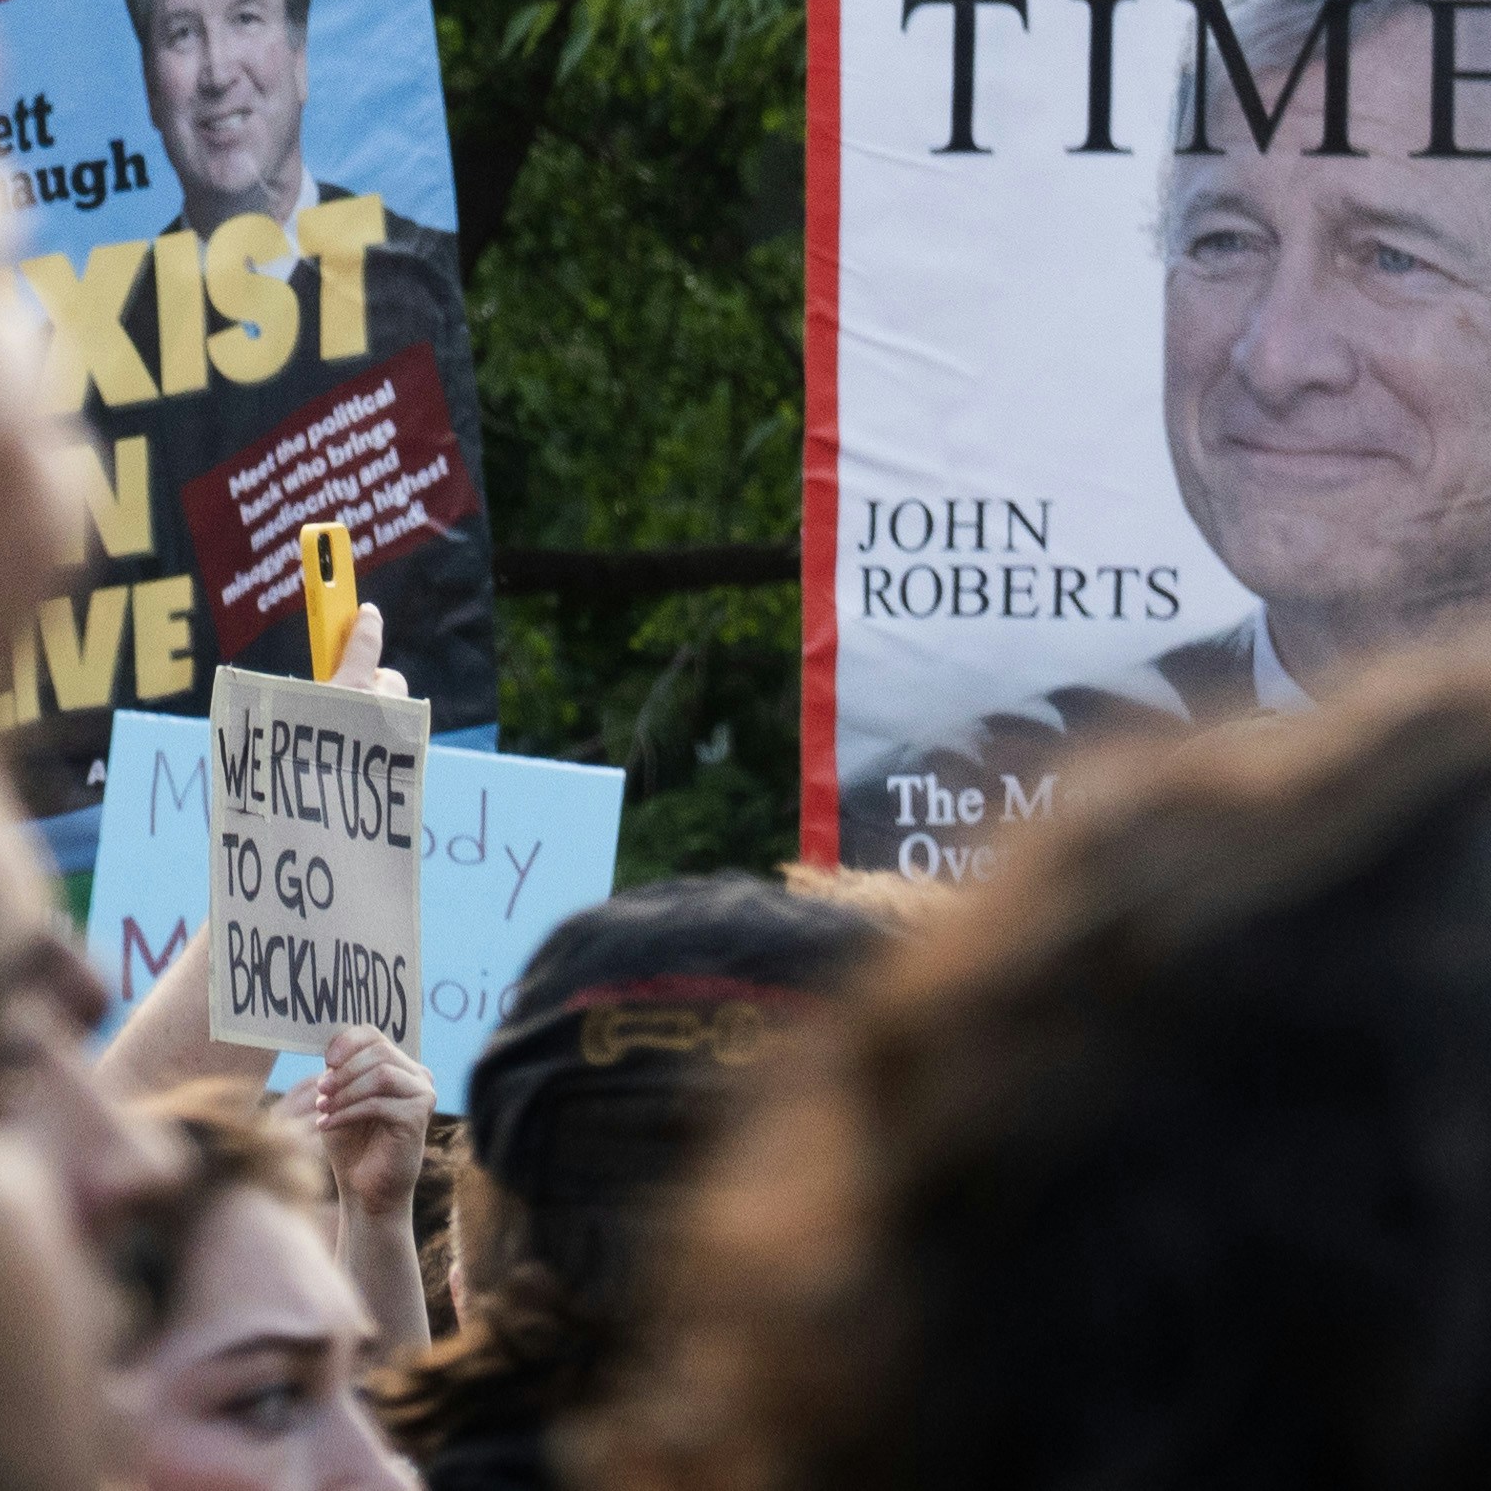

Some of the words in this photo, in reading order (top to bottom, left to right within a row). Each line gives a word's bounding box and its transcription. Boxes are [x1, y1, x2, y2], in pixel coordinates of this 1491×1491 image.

[8, 138, 151, 212] augh
[16, 192, 388, 415] XIST
[228, 451, 277, 500] Meet
[276, 432, 307, 466] the
[307, 378, 397, 450] political
[282, 457, 328, 494] who
[325, 419, 397, 469] brings
[250, 474, 360, 553] mediocrity
[359, 445, 401, 488] and
[372, 453, 449, 513] highest
[857, 497, 1051, 555] JOHN
[860, 563, 1180, 621] ROBERTS
[218, 708, 266, 816] WE
[270, 719, 415, 850] REFUSE
[886, 771, 986, 827] The
[999, 772, 1062, 824] M
[149, 748, 211, 838] M
[422, 788, 542, 921] dy
[222, 833, 262, 903] TO
[274, 848, 335, 920] GO
[898, 832, 998, 884] Ove
[121, 915, 189, 1003] M
[227, 920, 408, 1044] BACKWARDS
